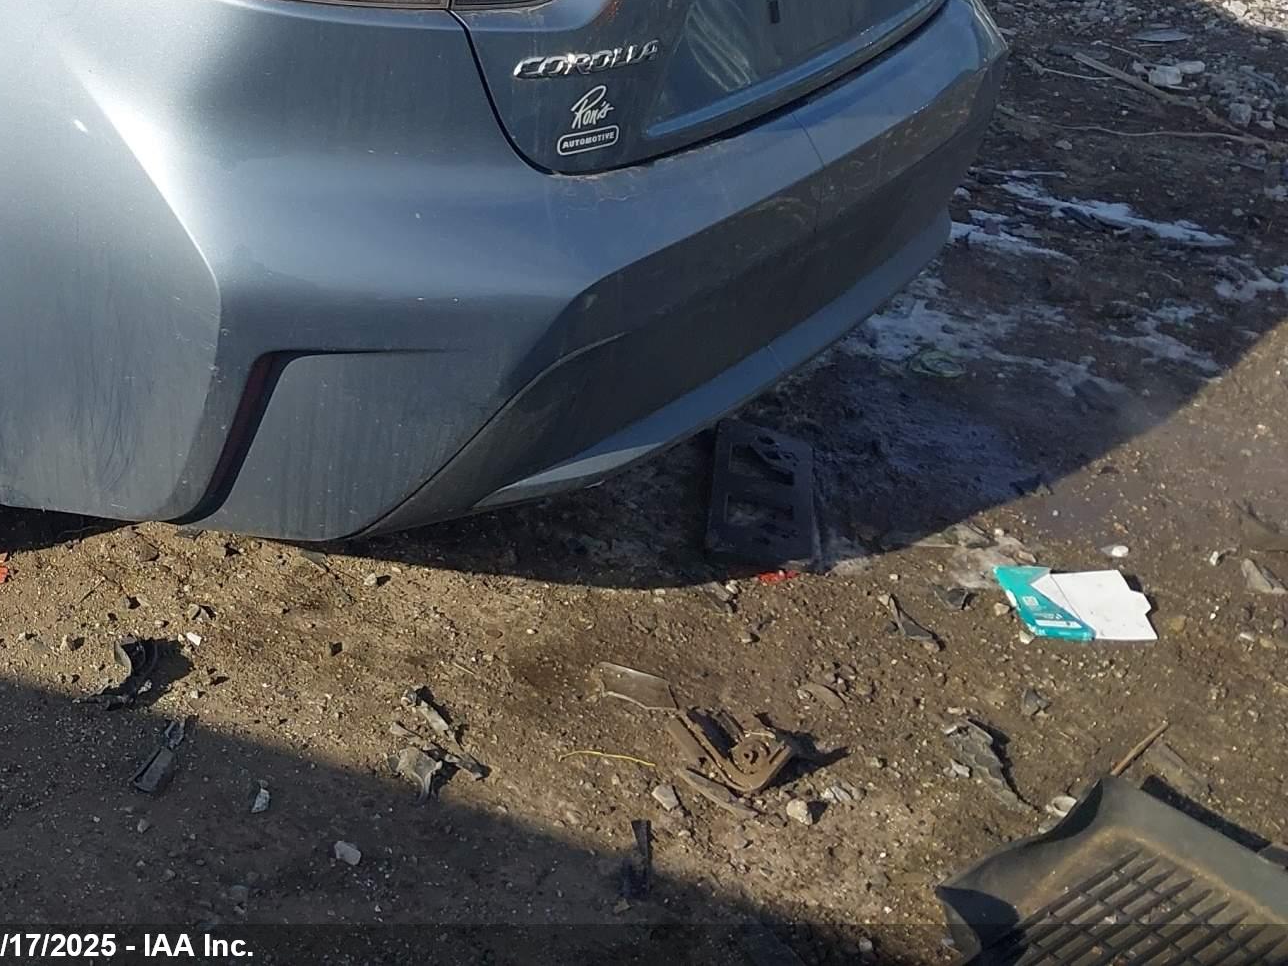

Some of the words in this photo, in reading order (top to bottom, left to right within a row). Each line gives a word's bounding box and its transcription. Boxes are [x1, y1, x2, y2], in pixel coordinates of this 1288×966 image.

[513, 40, 658, 78] COROLLA
[570, 85, 614, 128] Ron's
[562, 131, 615, 150] AUTOMOTIVE
